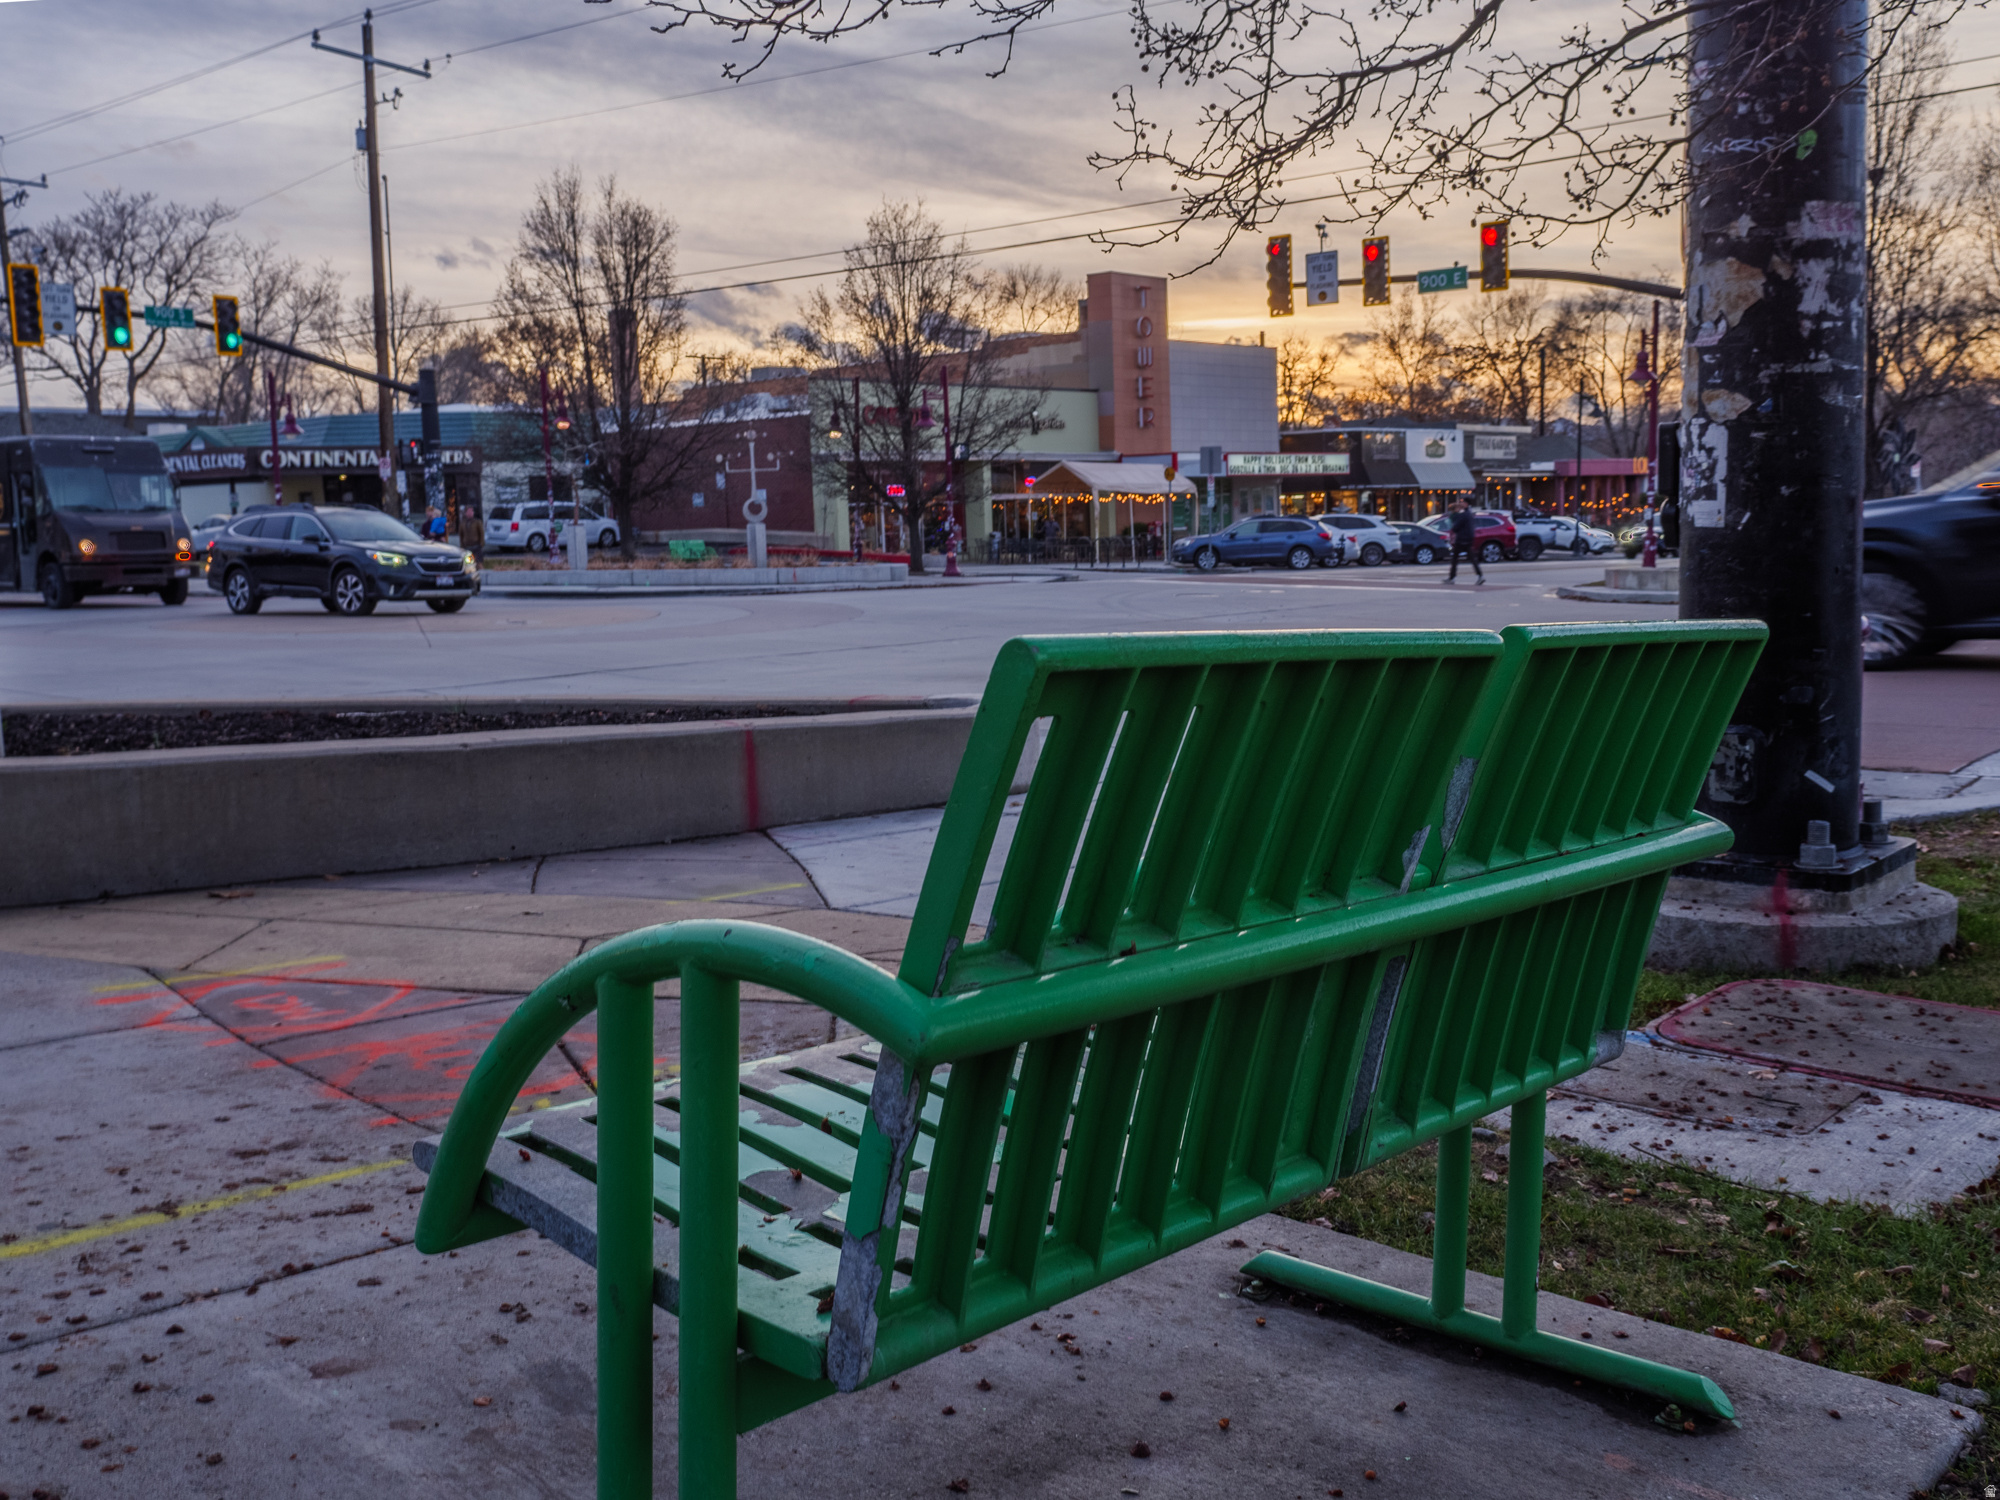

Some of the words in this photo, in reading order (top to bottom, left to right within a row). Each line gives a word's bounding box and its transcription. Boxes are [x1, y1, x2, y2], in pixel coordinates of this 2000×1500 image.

[1312, 262, 1333, 274] YIELD
[1420, 273, 1447, 289] 900
[45, 294, 69, 304] YIELD
[153, 306, 175, 319] 900
[1134, 286, 1155, 428] TOWER
[201, 453, 246, 470] CLEANERS
[1243, 454, 1262, 464] HAPPY
[1264, 454, 1292, 464] HOLIDAYS
[1294, 454, 1309, 464] FROM
[1229, 465, 1255, 475] GODZILLA
[1321, 464, 1348, 473] BROADWAY
